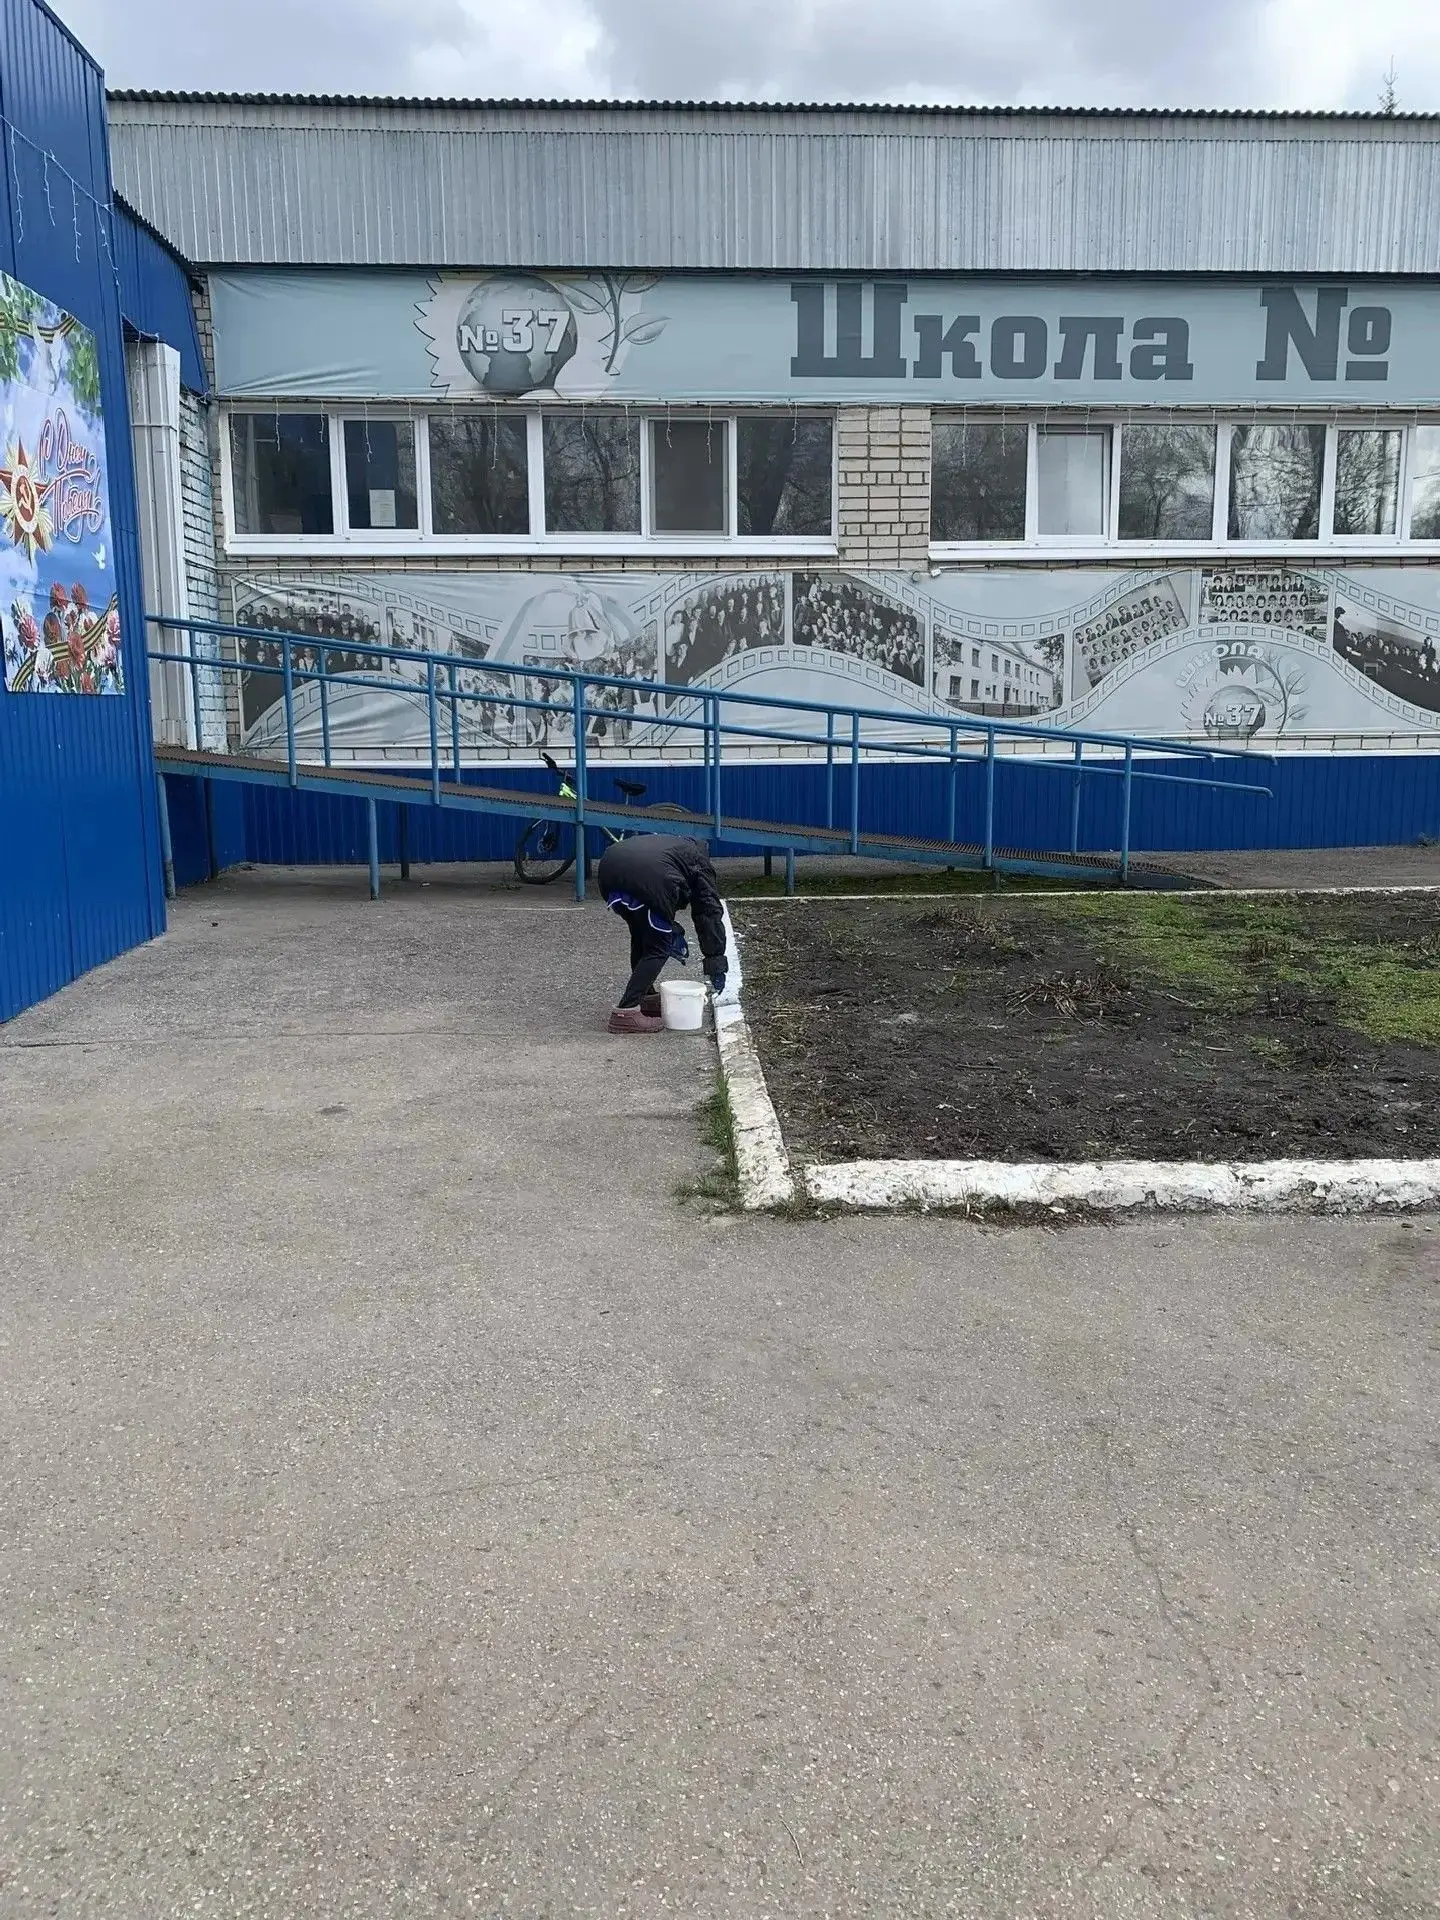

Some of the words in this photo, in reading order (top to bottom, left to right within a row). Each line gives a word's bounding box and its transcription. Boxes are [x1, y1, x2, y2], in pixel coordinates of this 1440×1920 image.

[790, 283, 1194, 380] Школа
[1256, 287, 1392, 381] №
[39, 418, 54, 482] С
